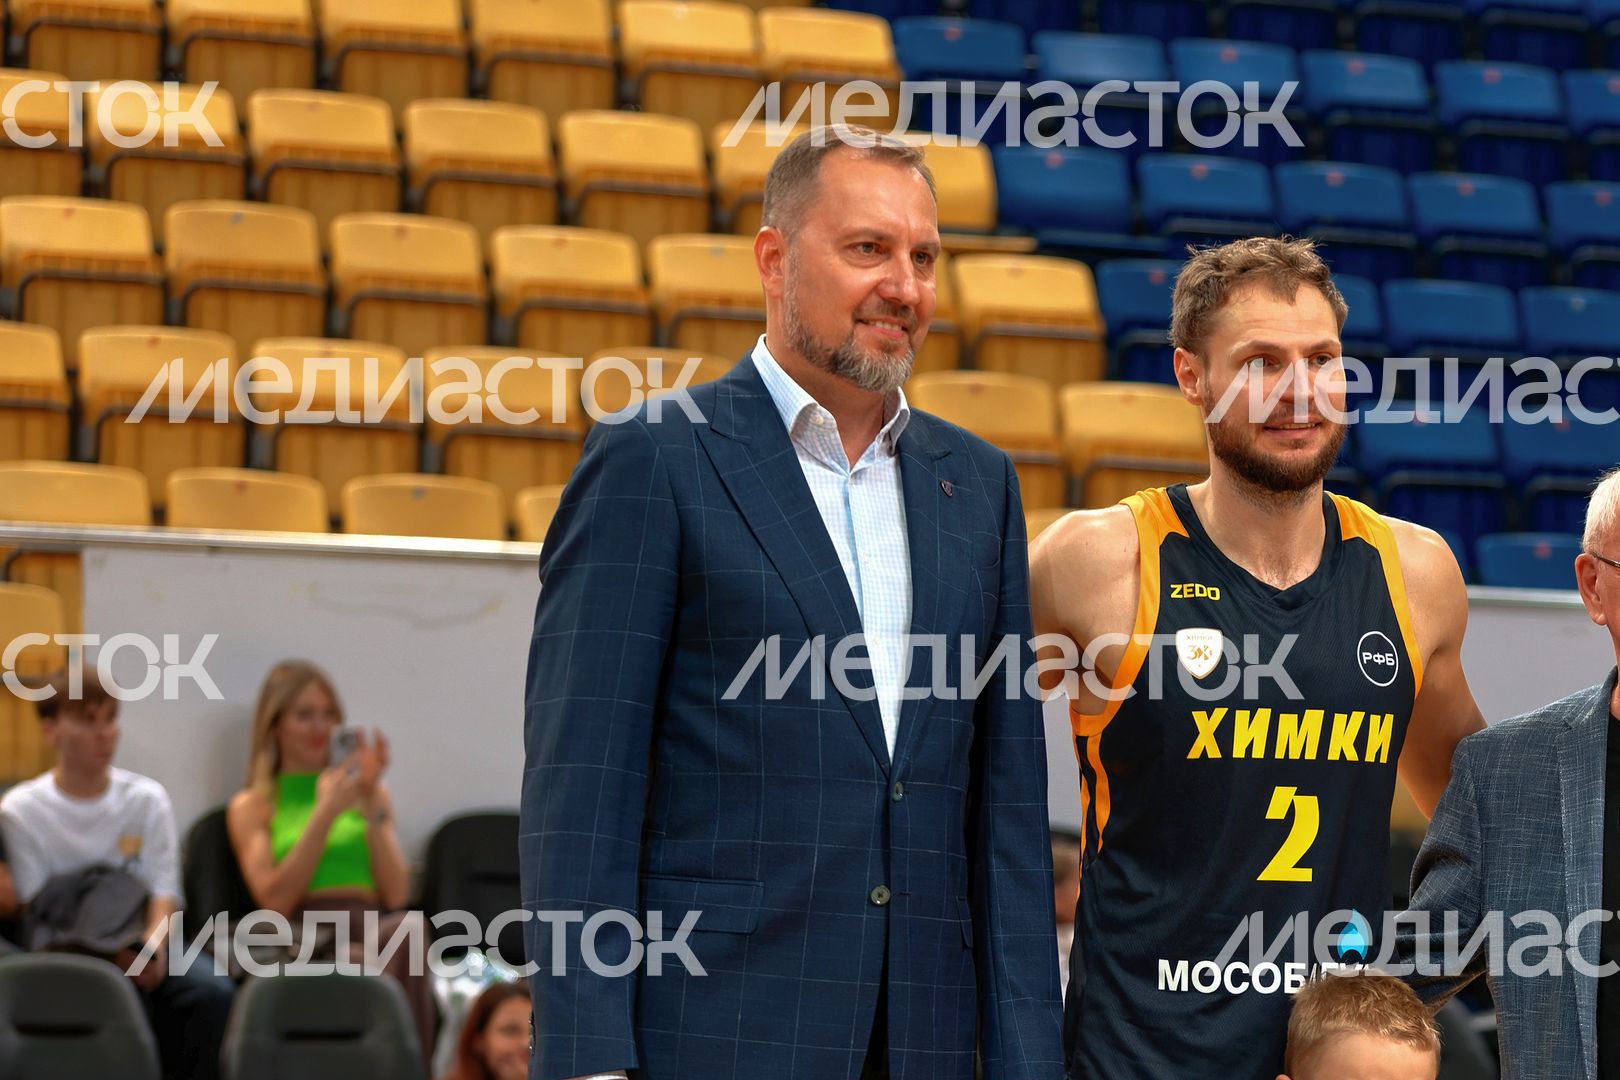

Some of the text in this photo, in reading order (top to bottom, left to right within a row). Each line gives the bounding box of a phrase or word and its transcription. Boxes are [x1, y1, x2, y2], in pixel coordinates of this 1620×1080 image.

[1169, 583, 1221, 601] ZEDO
[1362, 651, 1395, 667] РФБ
[1187, 707, 1394, 764] ХИМКИ
[1256, 785, 1320, 883] 2
